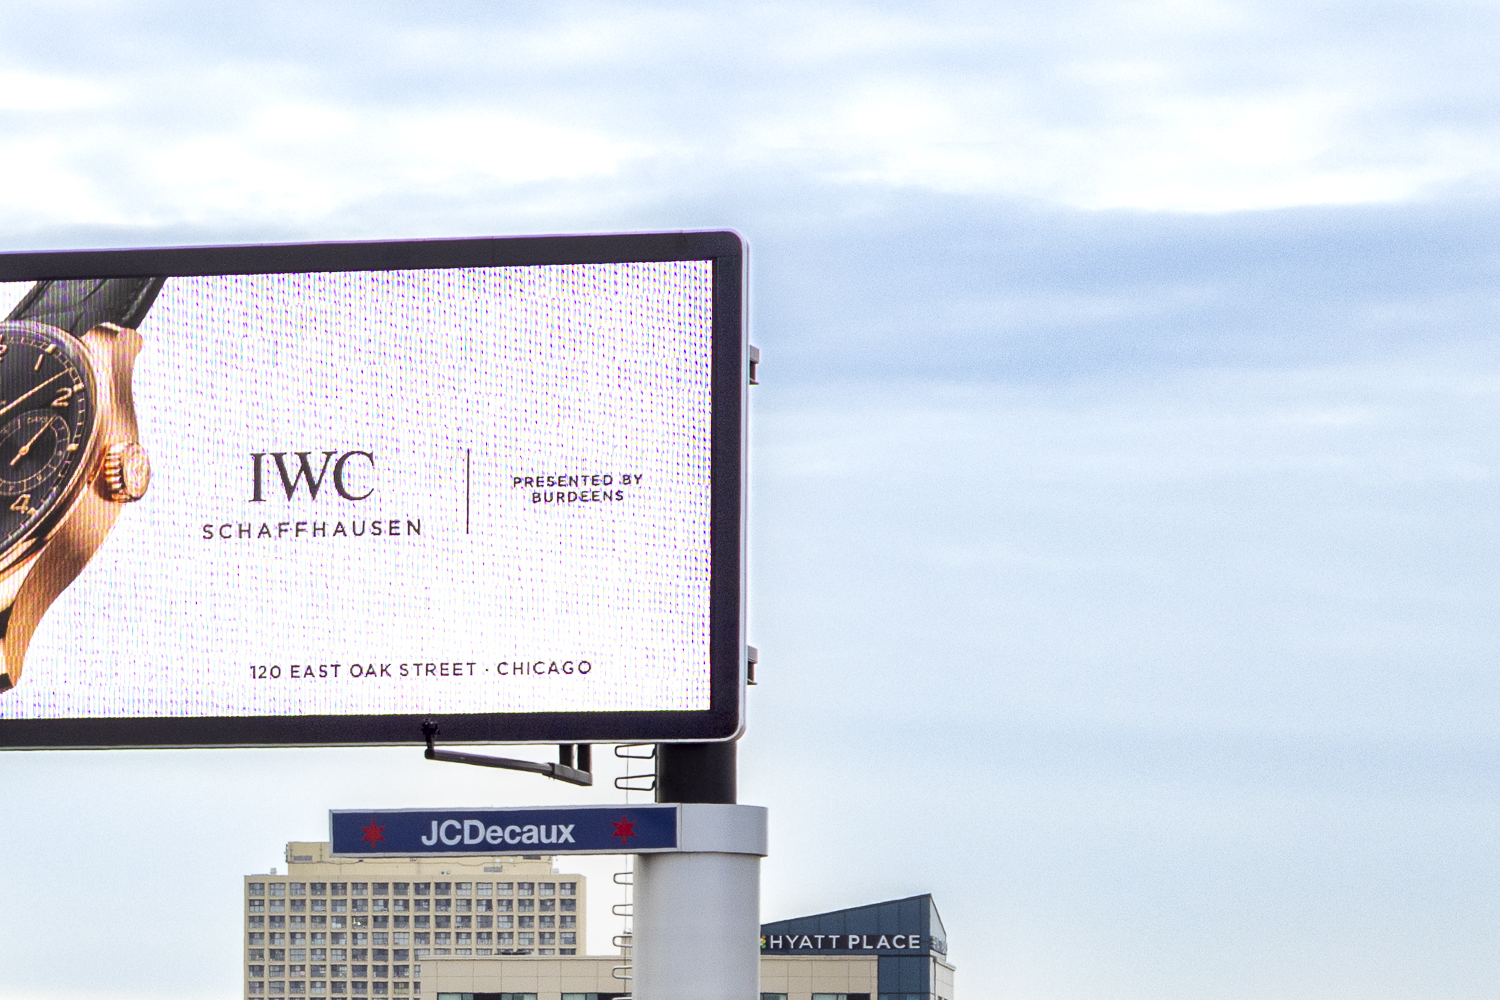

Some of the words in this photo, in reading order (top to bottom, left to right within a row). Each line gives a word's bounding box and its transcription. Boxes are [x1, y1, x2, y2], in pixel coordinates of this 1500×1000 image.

[51, 387, 73, 407] 2
[249, 451, 375, 502] IWC
[513, 474, 613, 488] PRESENTED
[622, 474, 643, 485] BY
[10, 494, 29, 514] 4
[532, 490, 624, 503] BURDEENS
[202, 519, 421, 539] SCHAFFHAUSEN
[250, 664, 281, 679] 120
[290, 663, 341, 679] EAST
[350, 663, 392, 678] OAK
[400, 662, 477, 677] STREET
[497, 660, 592, 675] CHICAGO
[421, 819, 576, 846] JCDecaux
[770, 935, 840, 949] HYATT
[848, 935, 921, 949] PLACE
